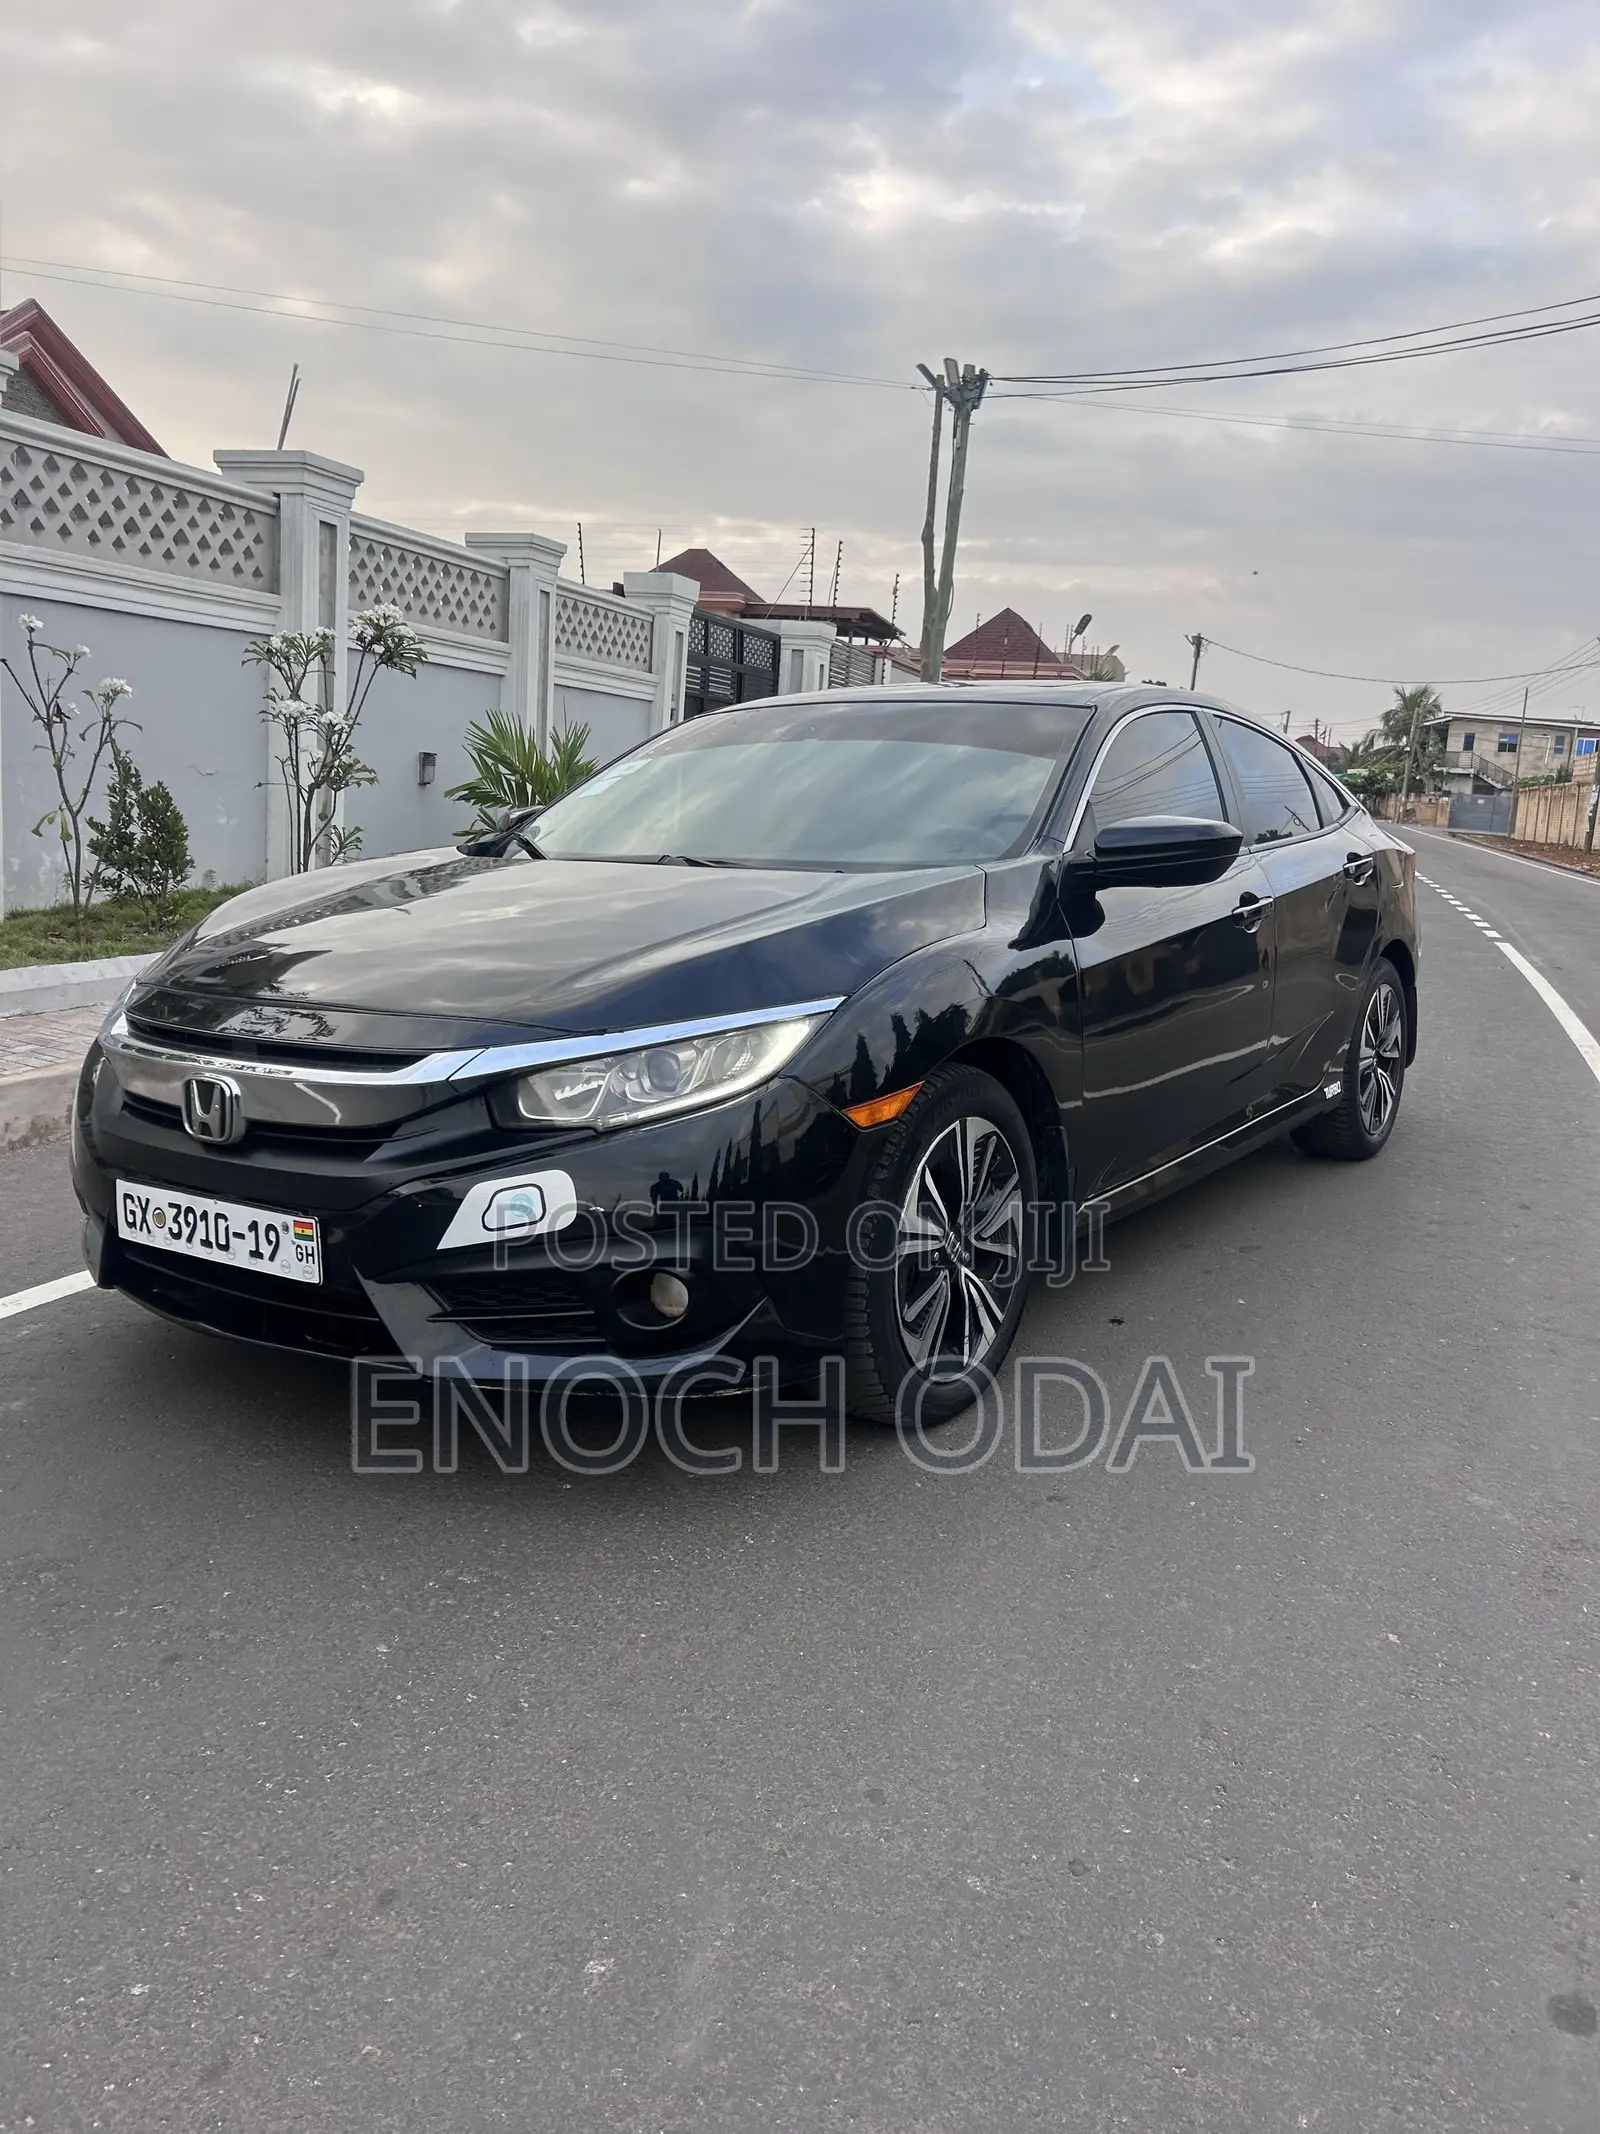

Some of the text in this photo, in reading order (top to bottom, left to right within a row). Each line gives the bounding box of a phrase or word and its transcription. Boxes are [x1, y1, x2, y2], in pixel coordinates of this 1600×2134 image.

[122, 1192, 280, 1262] GX 3910-19
[294, 1243, 316, 1265] GH
